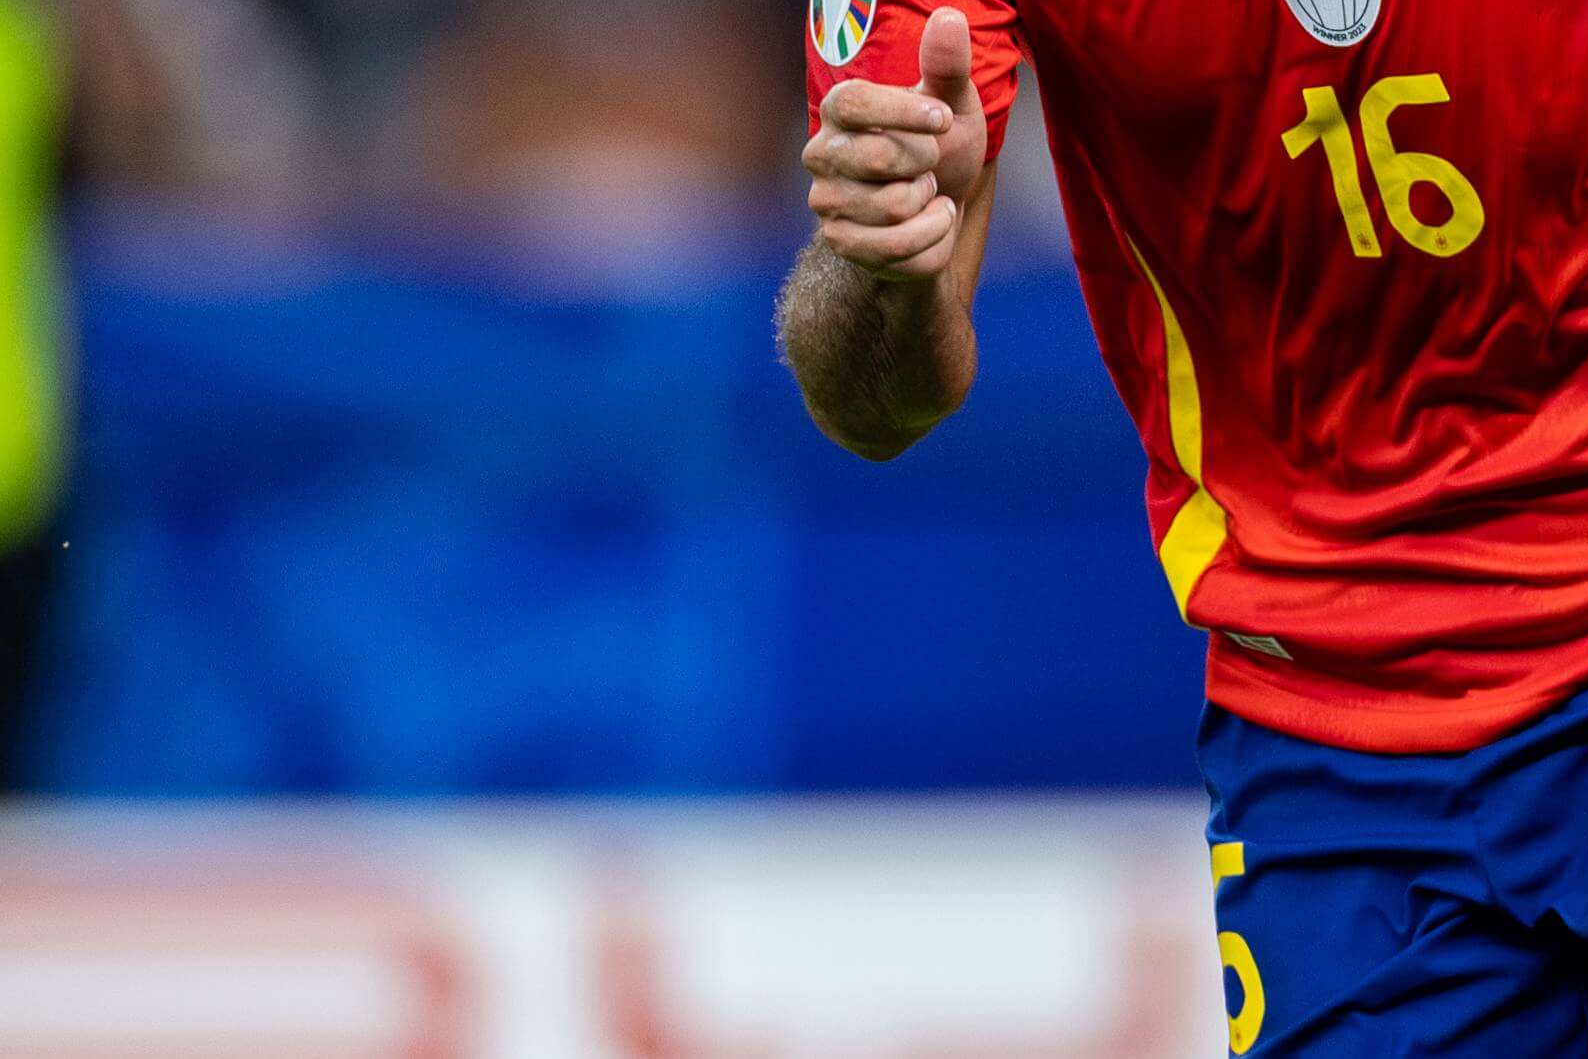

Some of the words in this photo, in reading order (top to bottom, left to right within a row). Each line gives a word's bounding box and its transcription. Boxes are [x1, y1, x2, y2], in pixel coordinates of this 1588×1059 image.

[1312, 24, 1347, 42] WINNER
[1347, 22, 1367, 40] 2023
[1281, 72, 1486, 258] 16
